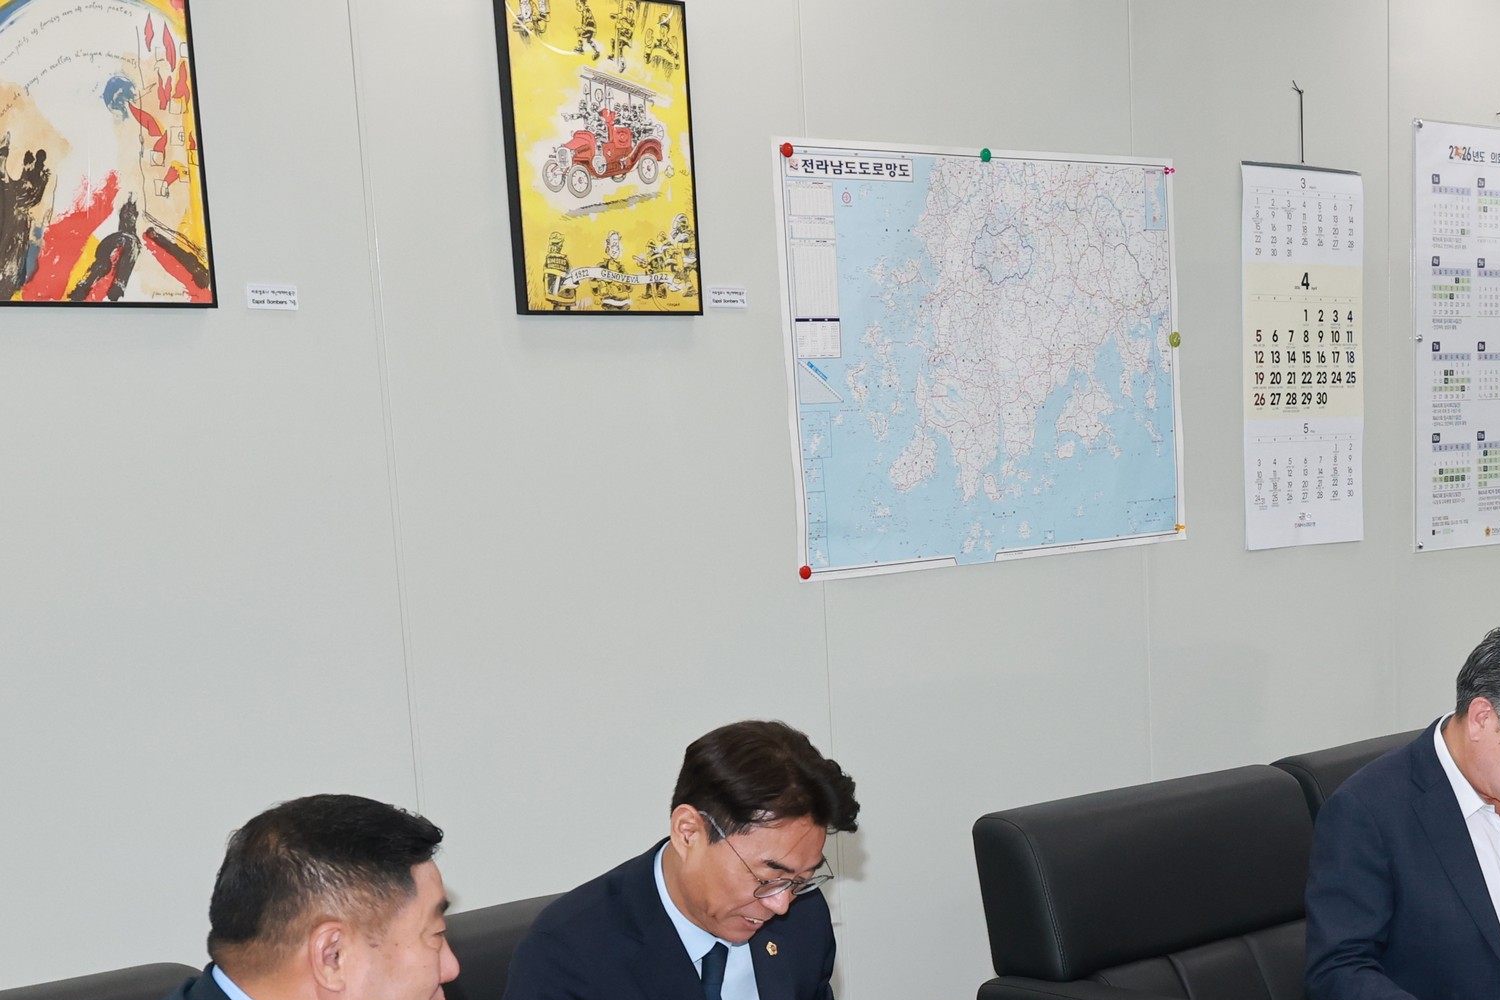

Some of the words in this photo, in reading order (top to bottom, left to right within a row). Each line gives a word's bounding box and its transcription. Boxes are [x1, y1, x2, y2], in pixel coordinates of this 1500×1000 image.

[802, 159, 910, 177] 전라남도도로망도
[1300, 178, 1306, 189] 3
[601, 270, 639, 283] GENOVEVA
[1301, 272, 1310, 290] 4
[1304, 309, 1308, 321] 1
[1318, 310, 1324, 322] 2
[1333, 310, 1338, 322] 3
[1347, 310, 1353, 322] 4
[1256, 330, 1262, 342] 5
[1272, 330, 1278, 342] 6
[1288, 330, 1294, 342] 7
[1304, 330, 1309, 342] 8
[1318, 330, 1323, 342] 9
[1331, 331, 1340, 342] 10
[1346, 331, 1352, 342] 11
[1254, 351, 1264, 363] 12
[1271, 351, 1280, 363] 13
[1287, 351, 1296, 363] 14
[1302, 351, 1311, 363] 15
[1317, 351, 1326, 363] 16
[1332, 351, 1340, 363] 17
[1346, 351, 1354, 363] 18
[1255, 372, 1264, 384] 19
[1270, 372, 1281, 384] 20
[1287, 372, 1295, 384] 21
[1302, 372, 1312, 384] 22
[1316, 372, 1327, 384] 23
[1331, 372, 1342, 384] 24
[1346, 371, 1356, 383] 25
[1254, 393, 1265, 406] 26
[1270, 393, 1281, 405] 27
[1286, 392, 1297, 405] 28
[1301, 392, 1312, 404] 29
[1316, 392, 1327, 404] 30
[1304, 423, 1309, 433] 5
